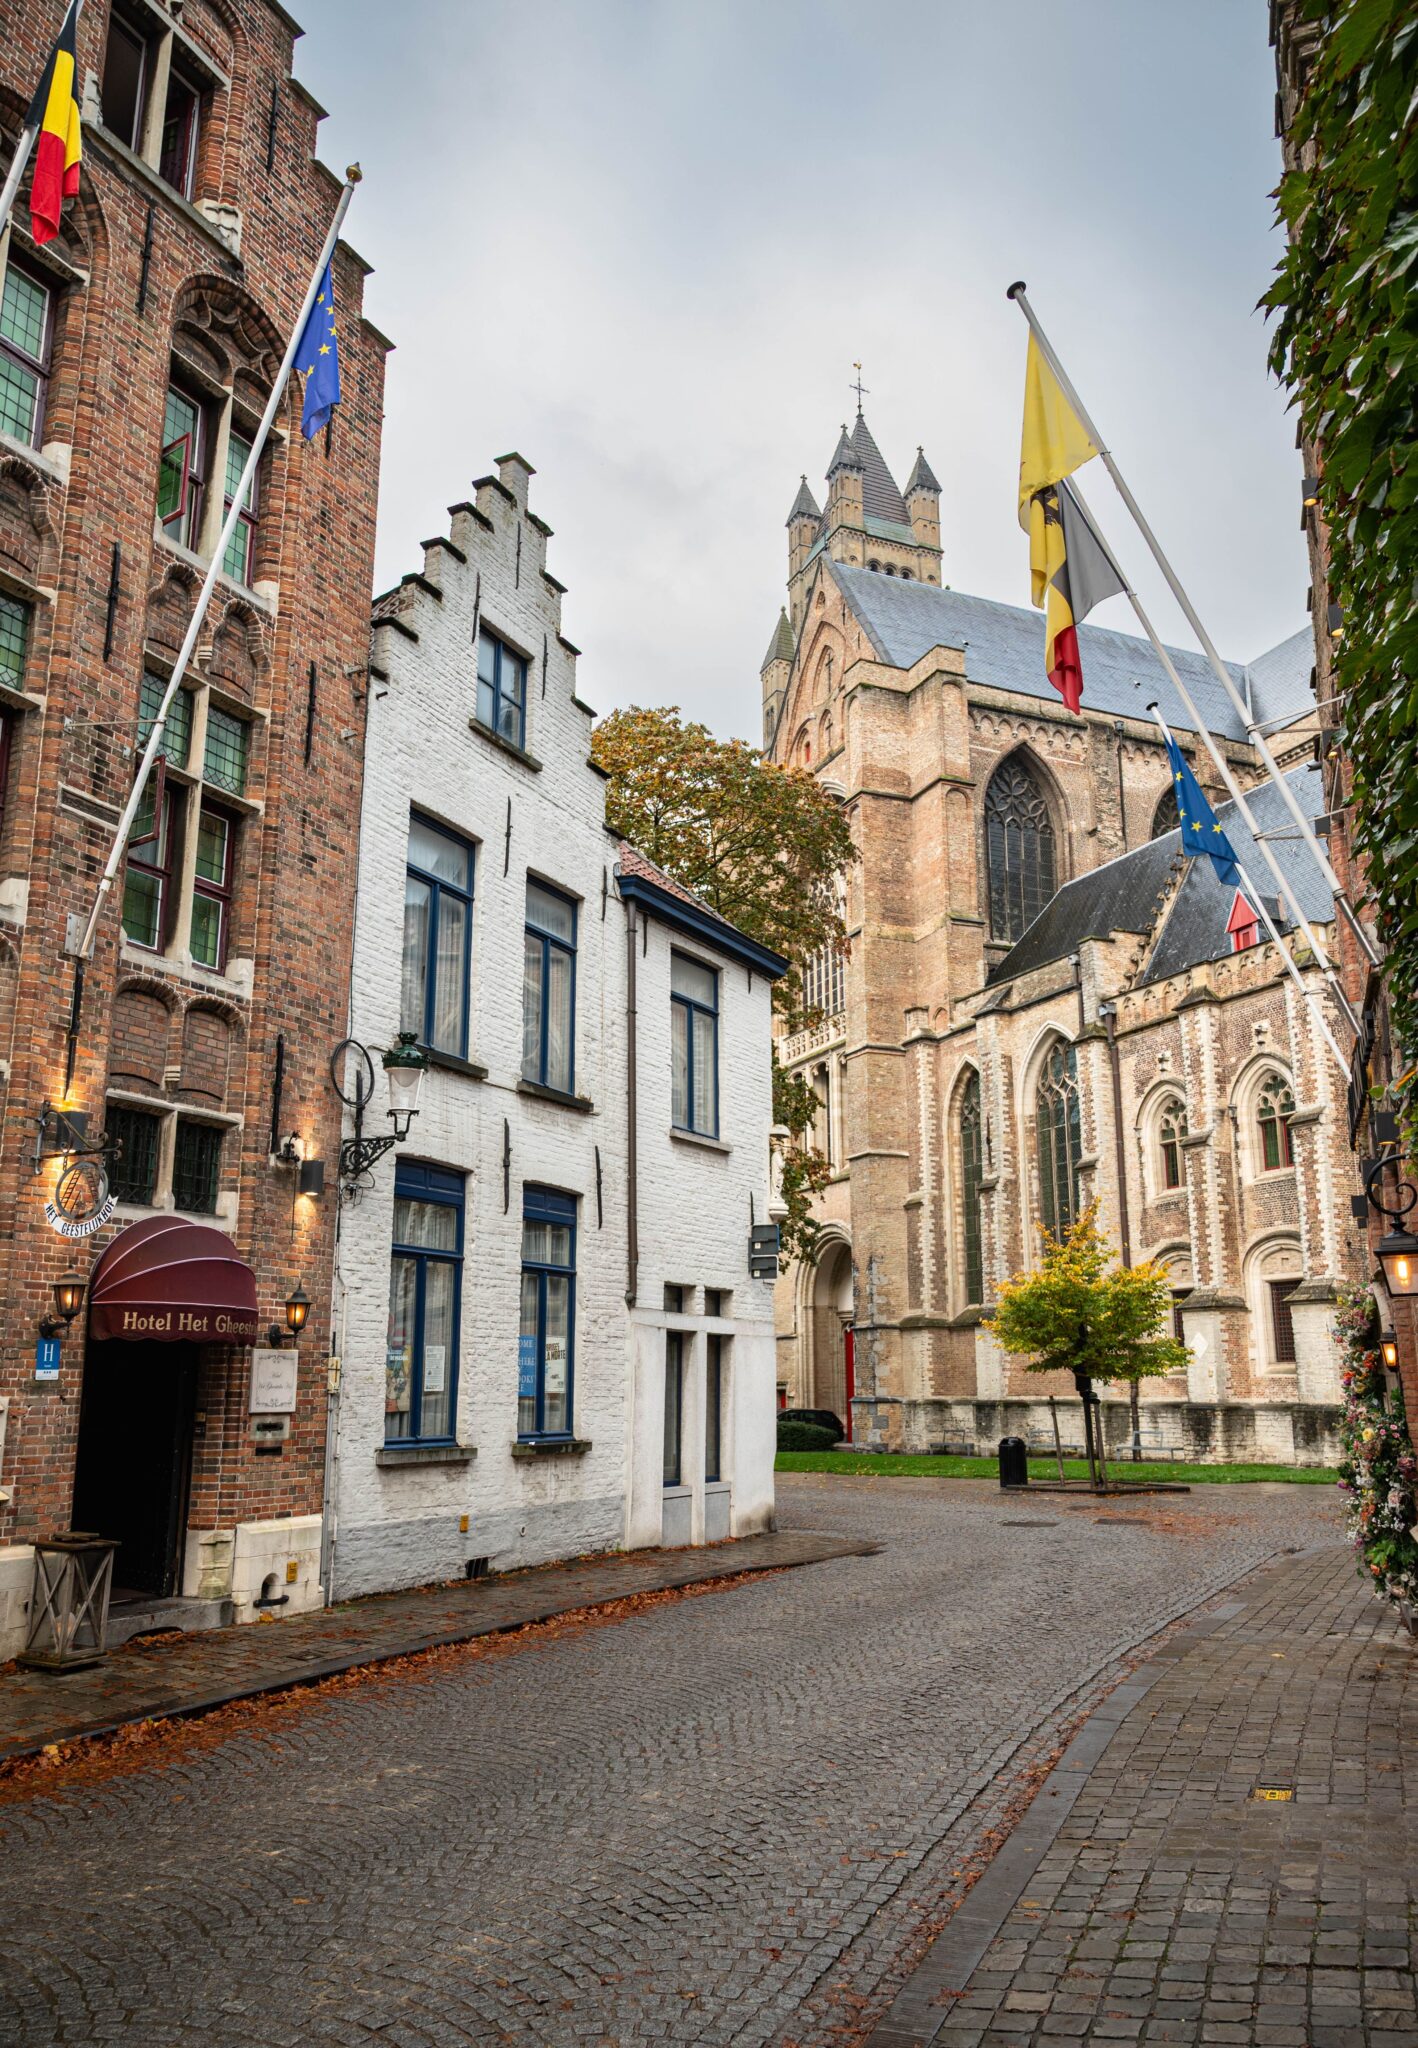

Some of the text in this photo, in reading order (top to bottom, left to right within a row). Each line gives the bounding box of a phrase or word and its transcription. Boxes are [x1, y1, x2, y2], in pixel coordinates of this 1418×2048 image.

[45, 1204, 58, 1223] HET
[123, 1312, 172, 1331] Hotel
[178, 1313, 208, 1332] Het
